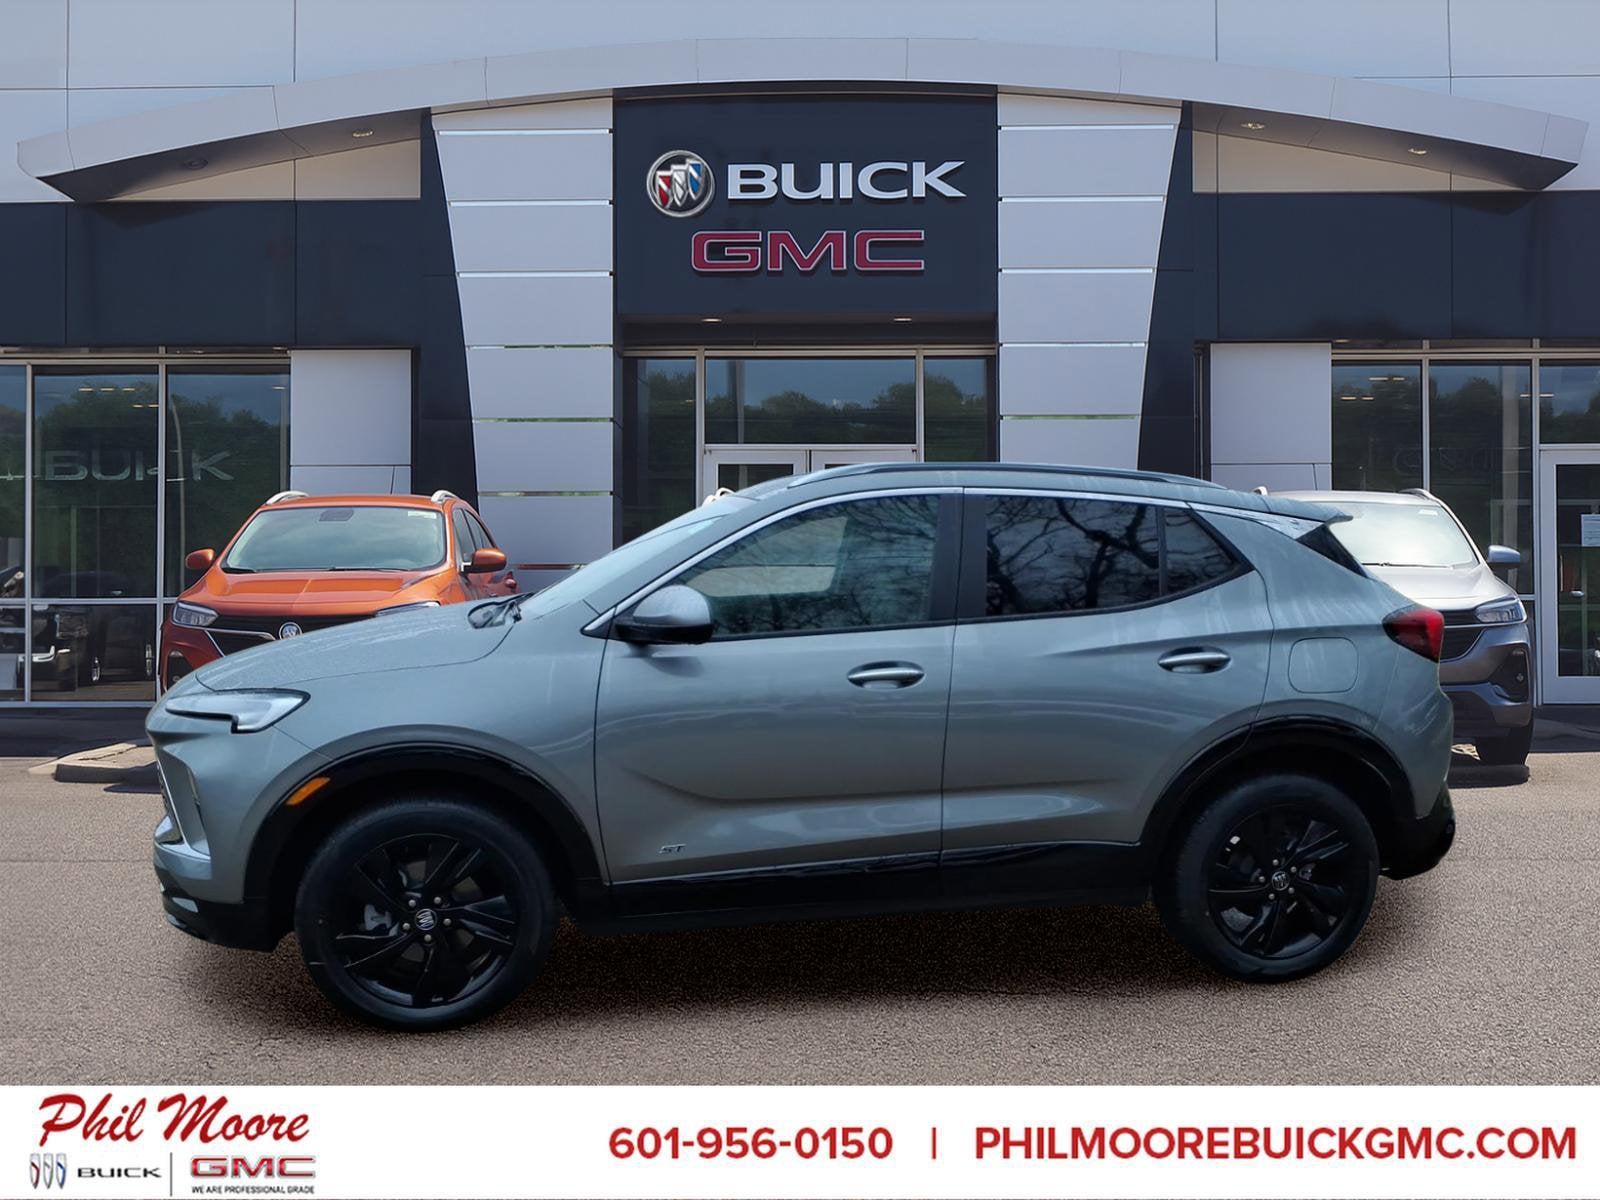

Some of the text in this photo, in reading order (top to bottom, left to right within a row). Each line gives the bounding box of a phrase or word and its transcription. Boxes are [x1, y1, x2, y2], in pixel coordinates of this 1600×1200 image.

[727, 160, 967, 199] BUICK
[692, 230, 925, 272] GMC
[45, 450, 235, 481] BUIK
